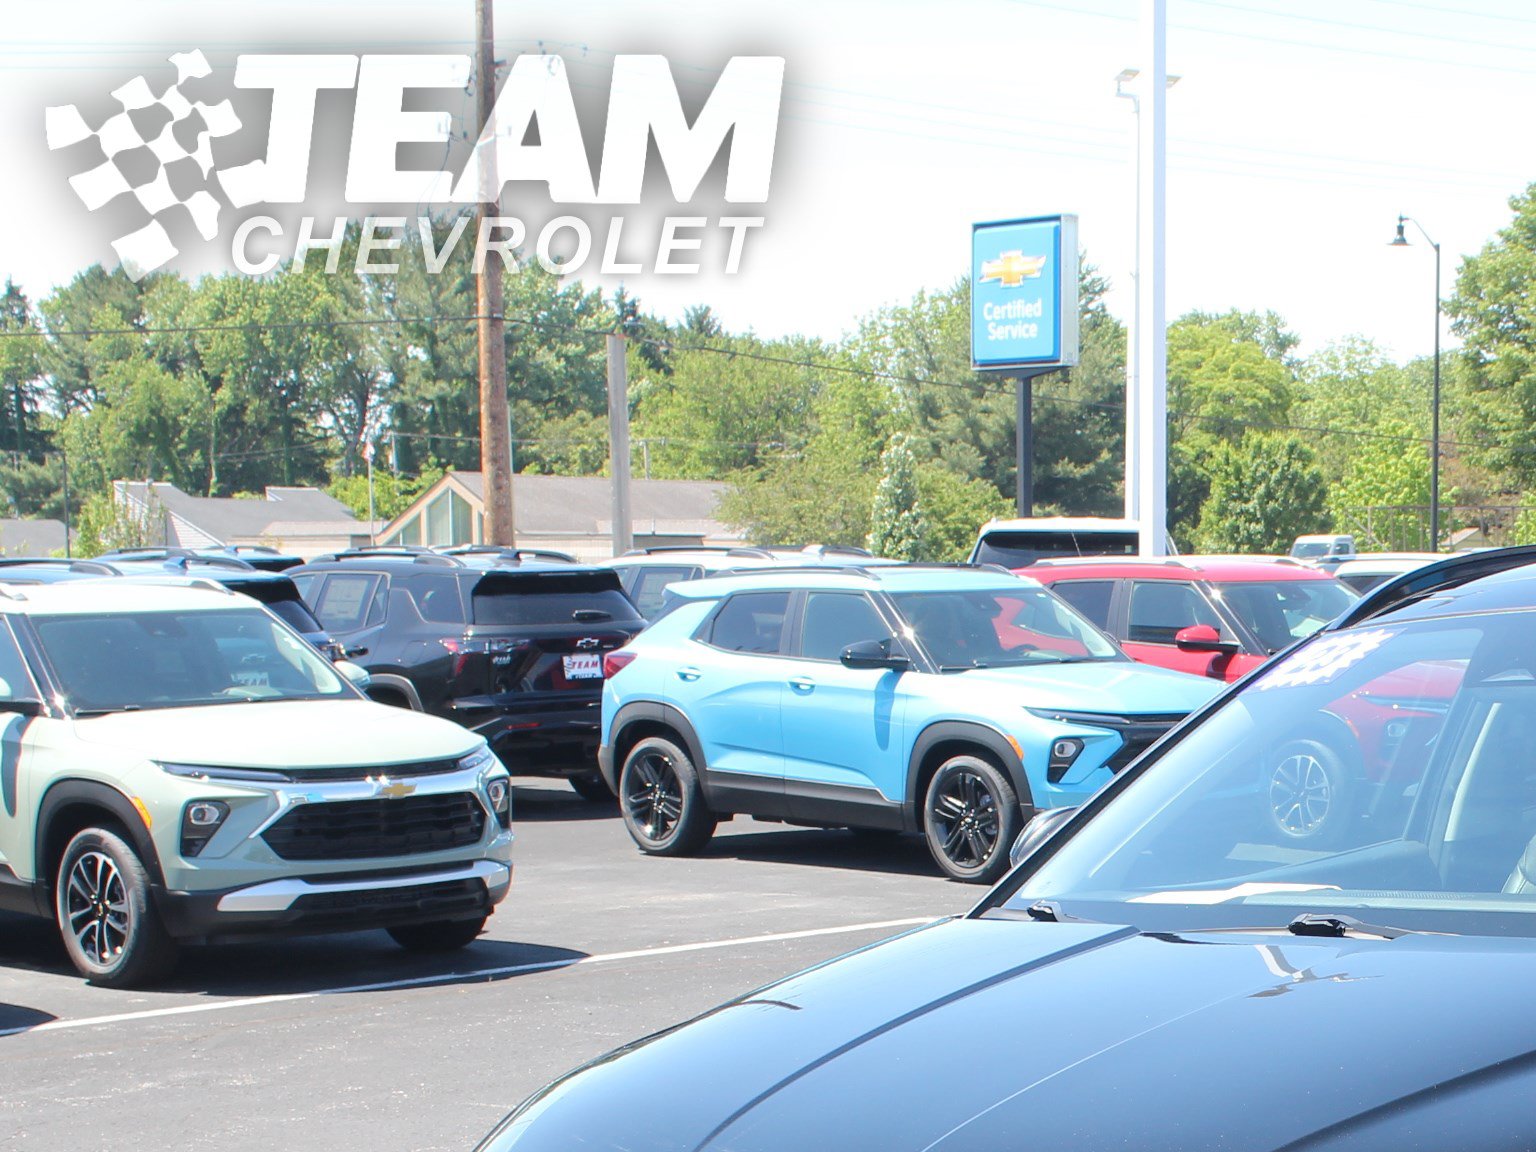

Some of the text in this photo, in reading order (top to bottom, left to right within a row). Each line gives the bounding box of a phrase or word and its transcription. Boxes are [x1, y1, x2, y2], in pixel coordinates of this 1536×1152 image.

[983, 299, 1041, 320] Certified
[988, 321, 1037, 340] Service
[571, 660, 599, 669] TEAM
